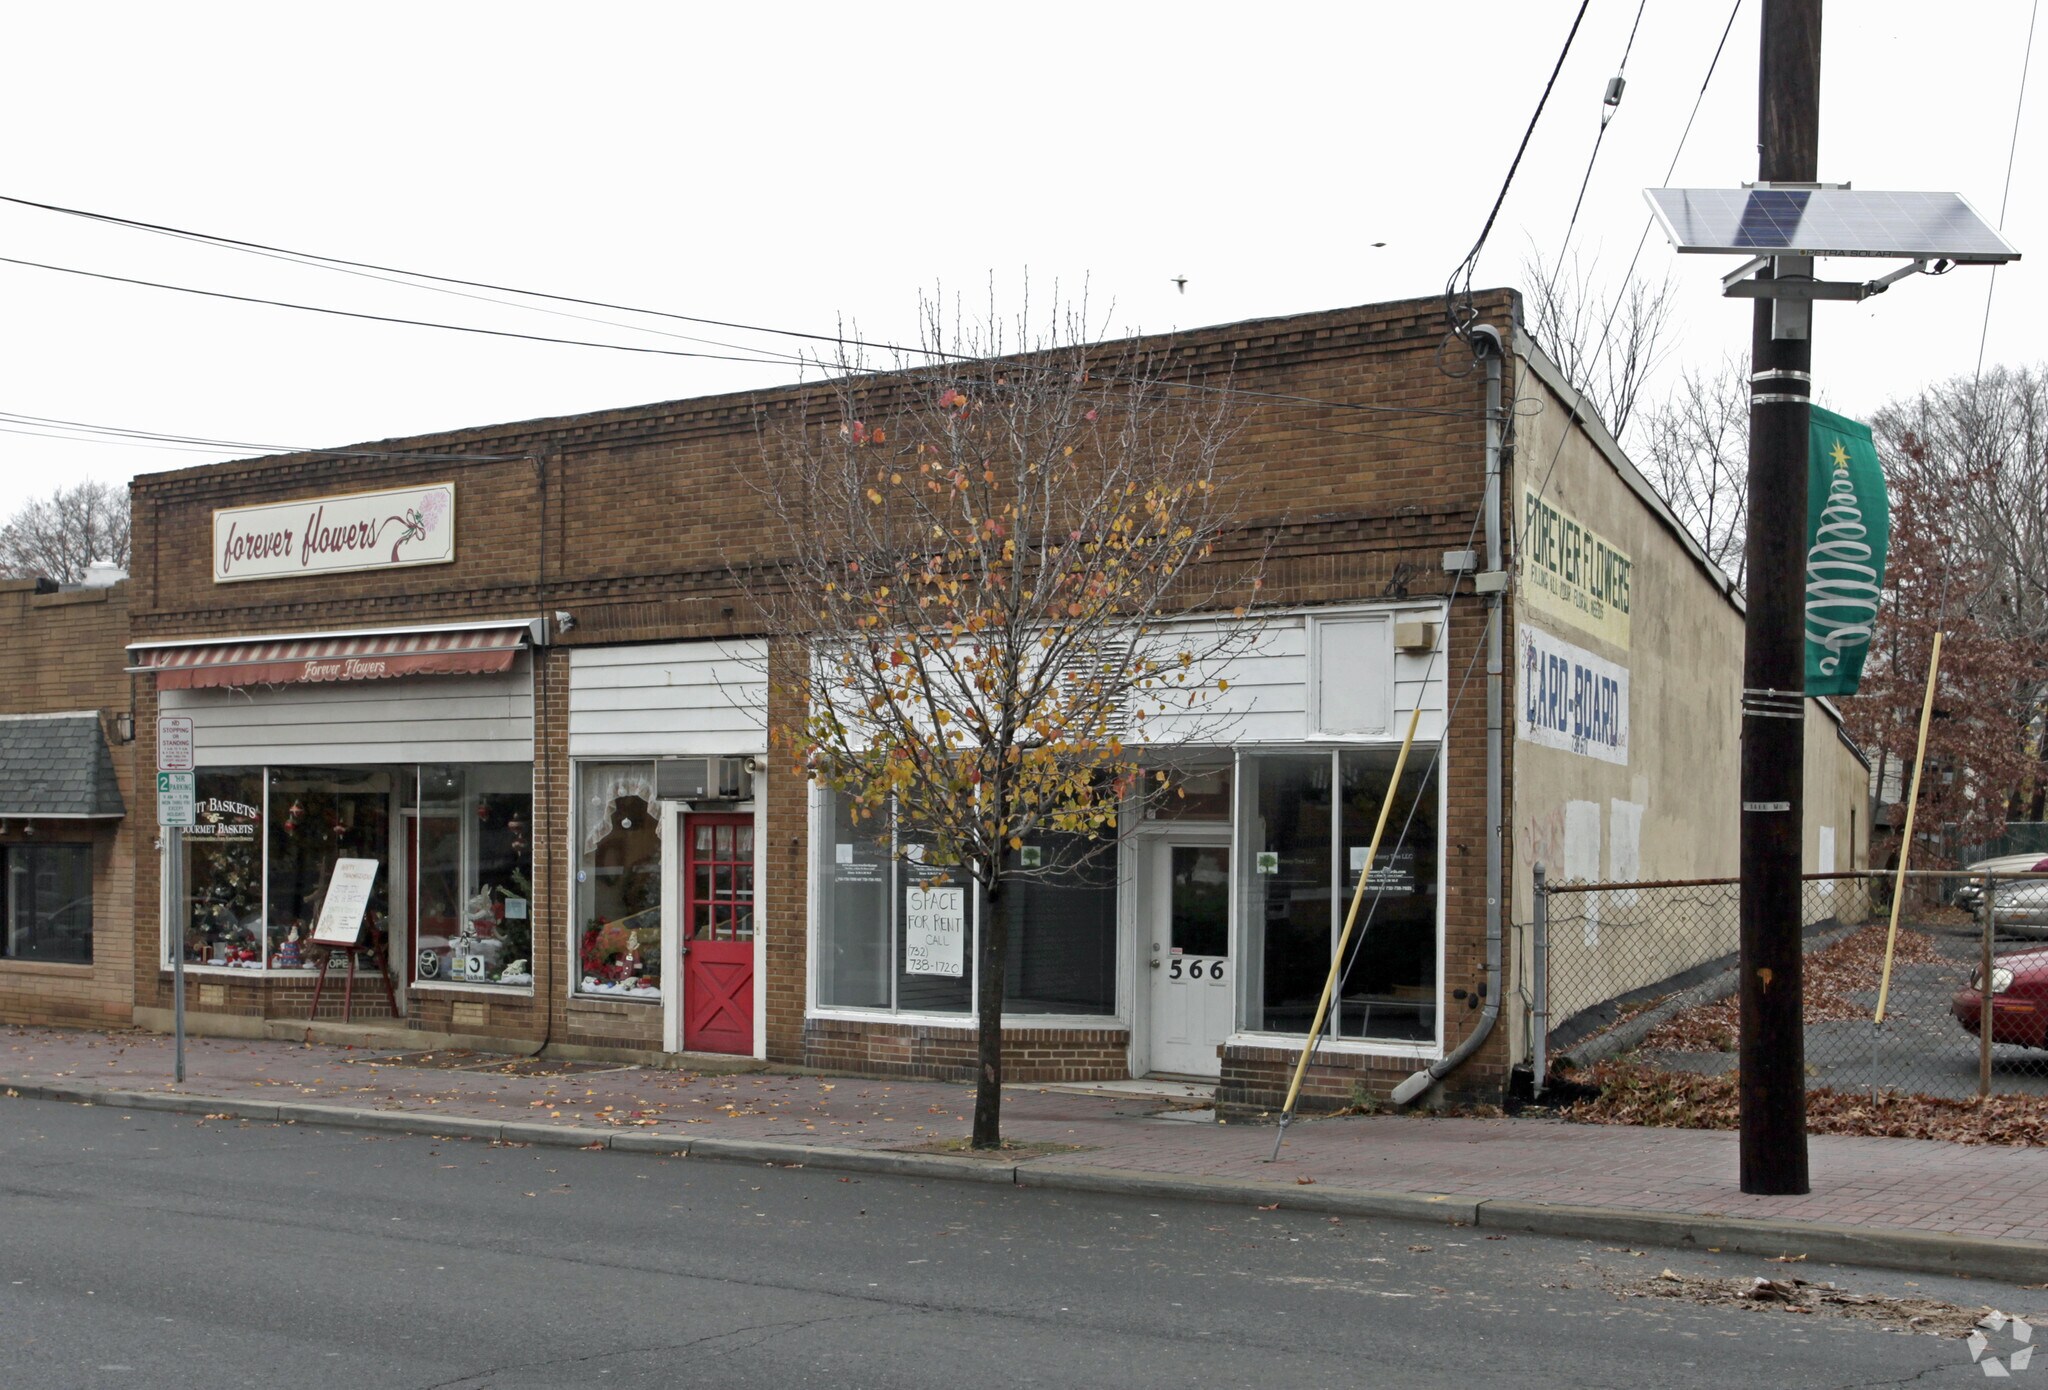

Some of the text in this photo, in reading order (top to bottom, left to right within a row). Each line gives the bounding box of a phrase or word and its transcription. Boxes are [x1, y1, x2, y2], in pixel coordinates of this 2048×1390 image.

[223, 506, 378, 573] forever flowers
[1526, 492, 1630, 615] FOREVER FLOWERS
[301, 658, 386, 679] Forever Flowers
[1526, 644, 1619, 747] CARD-BOARD
[160, 776, 168, 791] 2
[209, 797, 257, 819] BASKETS
[217, 822, 254, 834] BASKETS
[911, 892, 958, 911] SPACE
[908, 914, 962, 933] FOR RENT
[926, 934, 950, 947] CALL
[907, 944, 929, 957] (732)
[329, 958, 349, 969] OPE
[909, 959, 959, 974] 738-1720
[1169, 959, 1225, 980] 566
